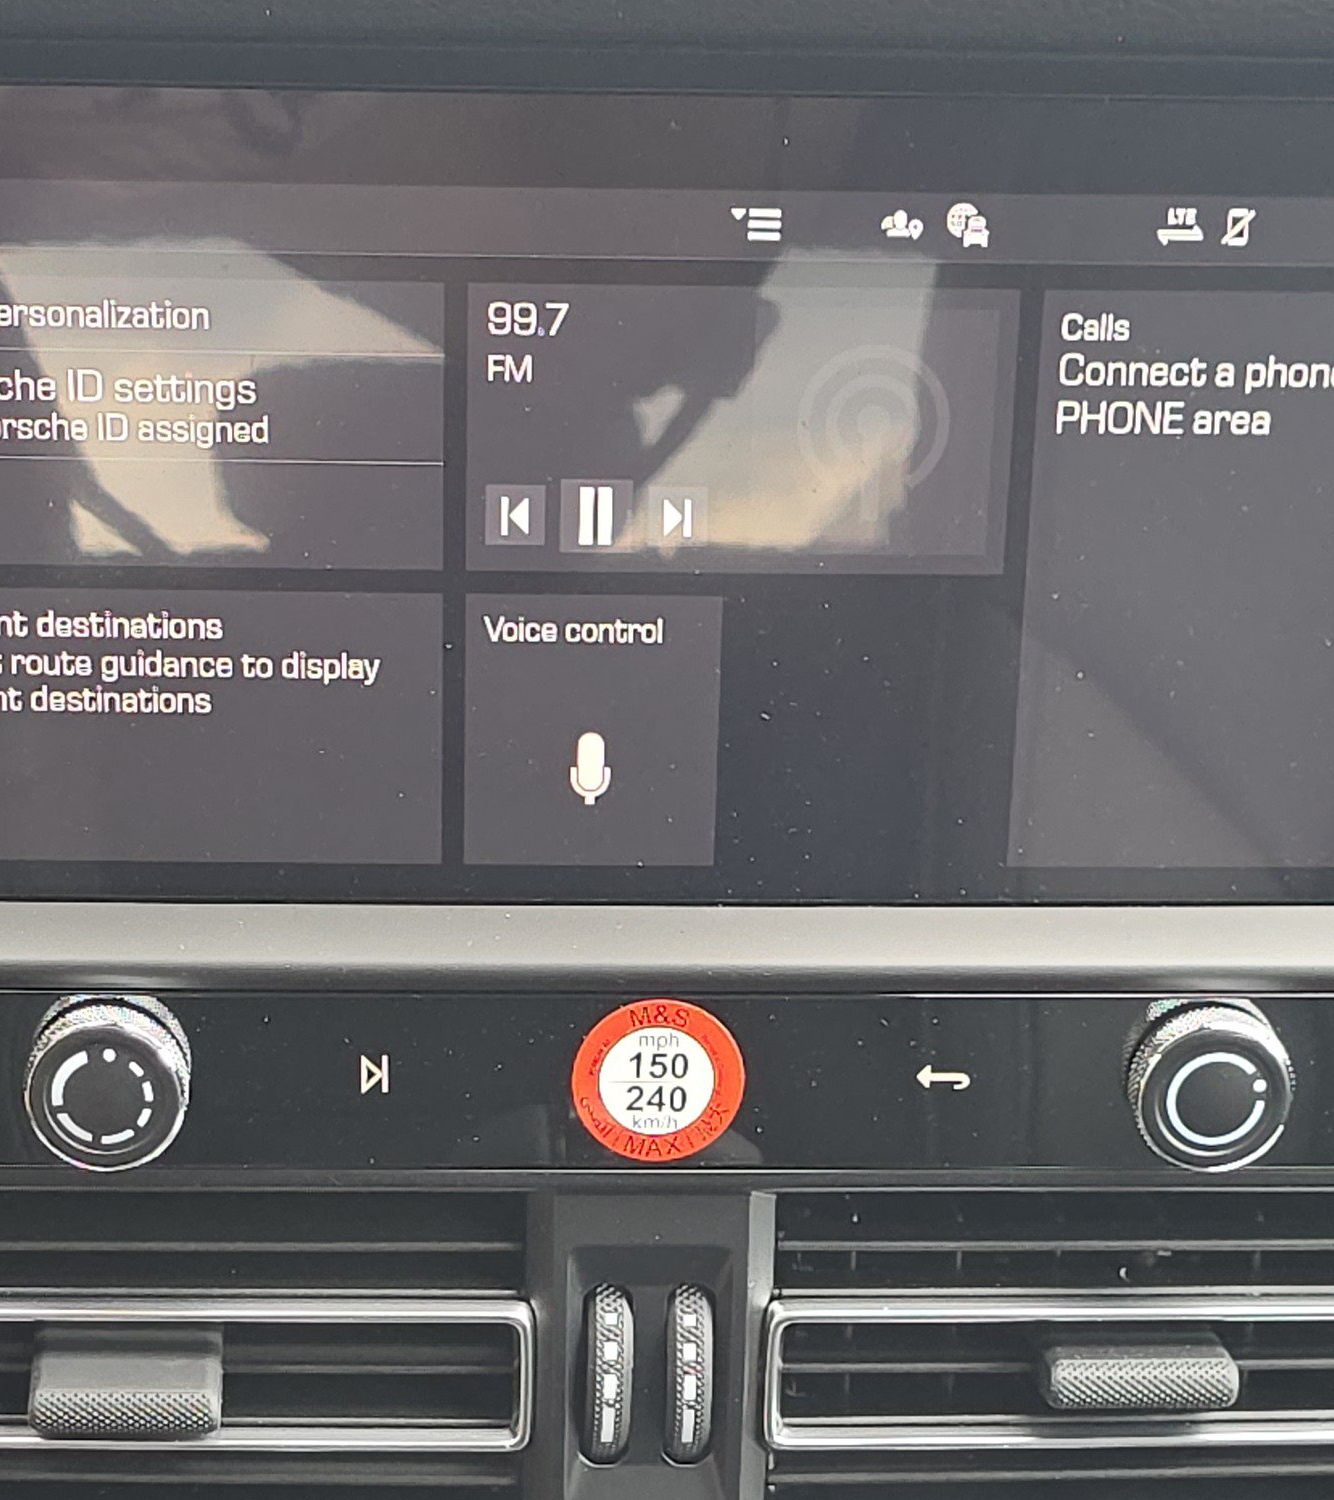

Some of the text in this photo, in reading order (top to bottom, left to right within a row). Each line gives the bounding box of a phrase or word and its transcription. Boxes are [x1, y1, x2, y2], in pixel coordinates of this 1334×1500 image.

[1166, 207, 1198, 226] LTE
[487, 301, 570, 337] 99.7
[1061, 312, 1130, 342] Calls
[487, 354, 533, 383] FM
[1059, 352, 1208, 388] Connect
[1214, 362, 1235, 388] a
[63, 369, 103, 403] ID
[114, 371, 256, 409] settings
[97, 412, 128, 441] ID
[135, 413, 269, 449] assigned
[1056, 400, 1272, 436] PHONE area
[36, 609, 224, 640] destinations
[483, 615, 664, 644] Voice control
[11, 650, 93, 676] route
[101, 649, 233, 683] guidance
[240, 653, 274, 679] to
[281, 650, 381, 686] display
[30, 685, 212, 714] destinations
[629, 1004, 690, 1027] M&S
[639, 1033, 679, 1051] mph
[629, 1052, 689, 1079] 150
[626, 1086, 687, 1112] 240
[623, 1135, 683, 1157] MAX
